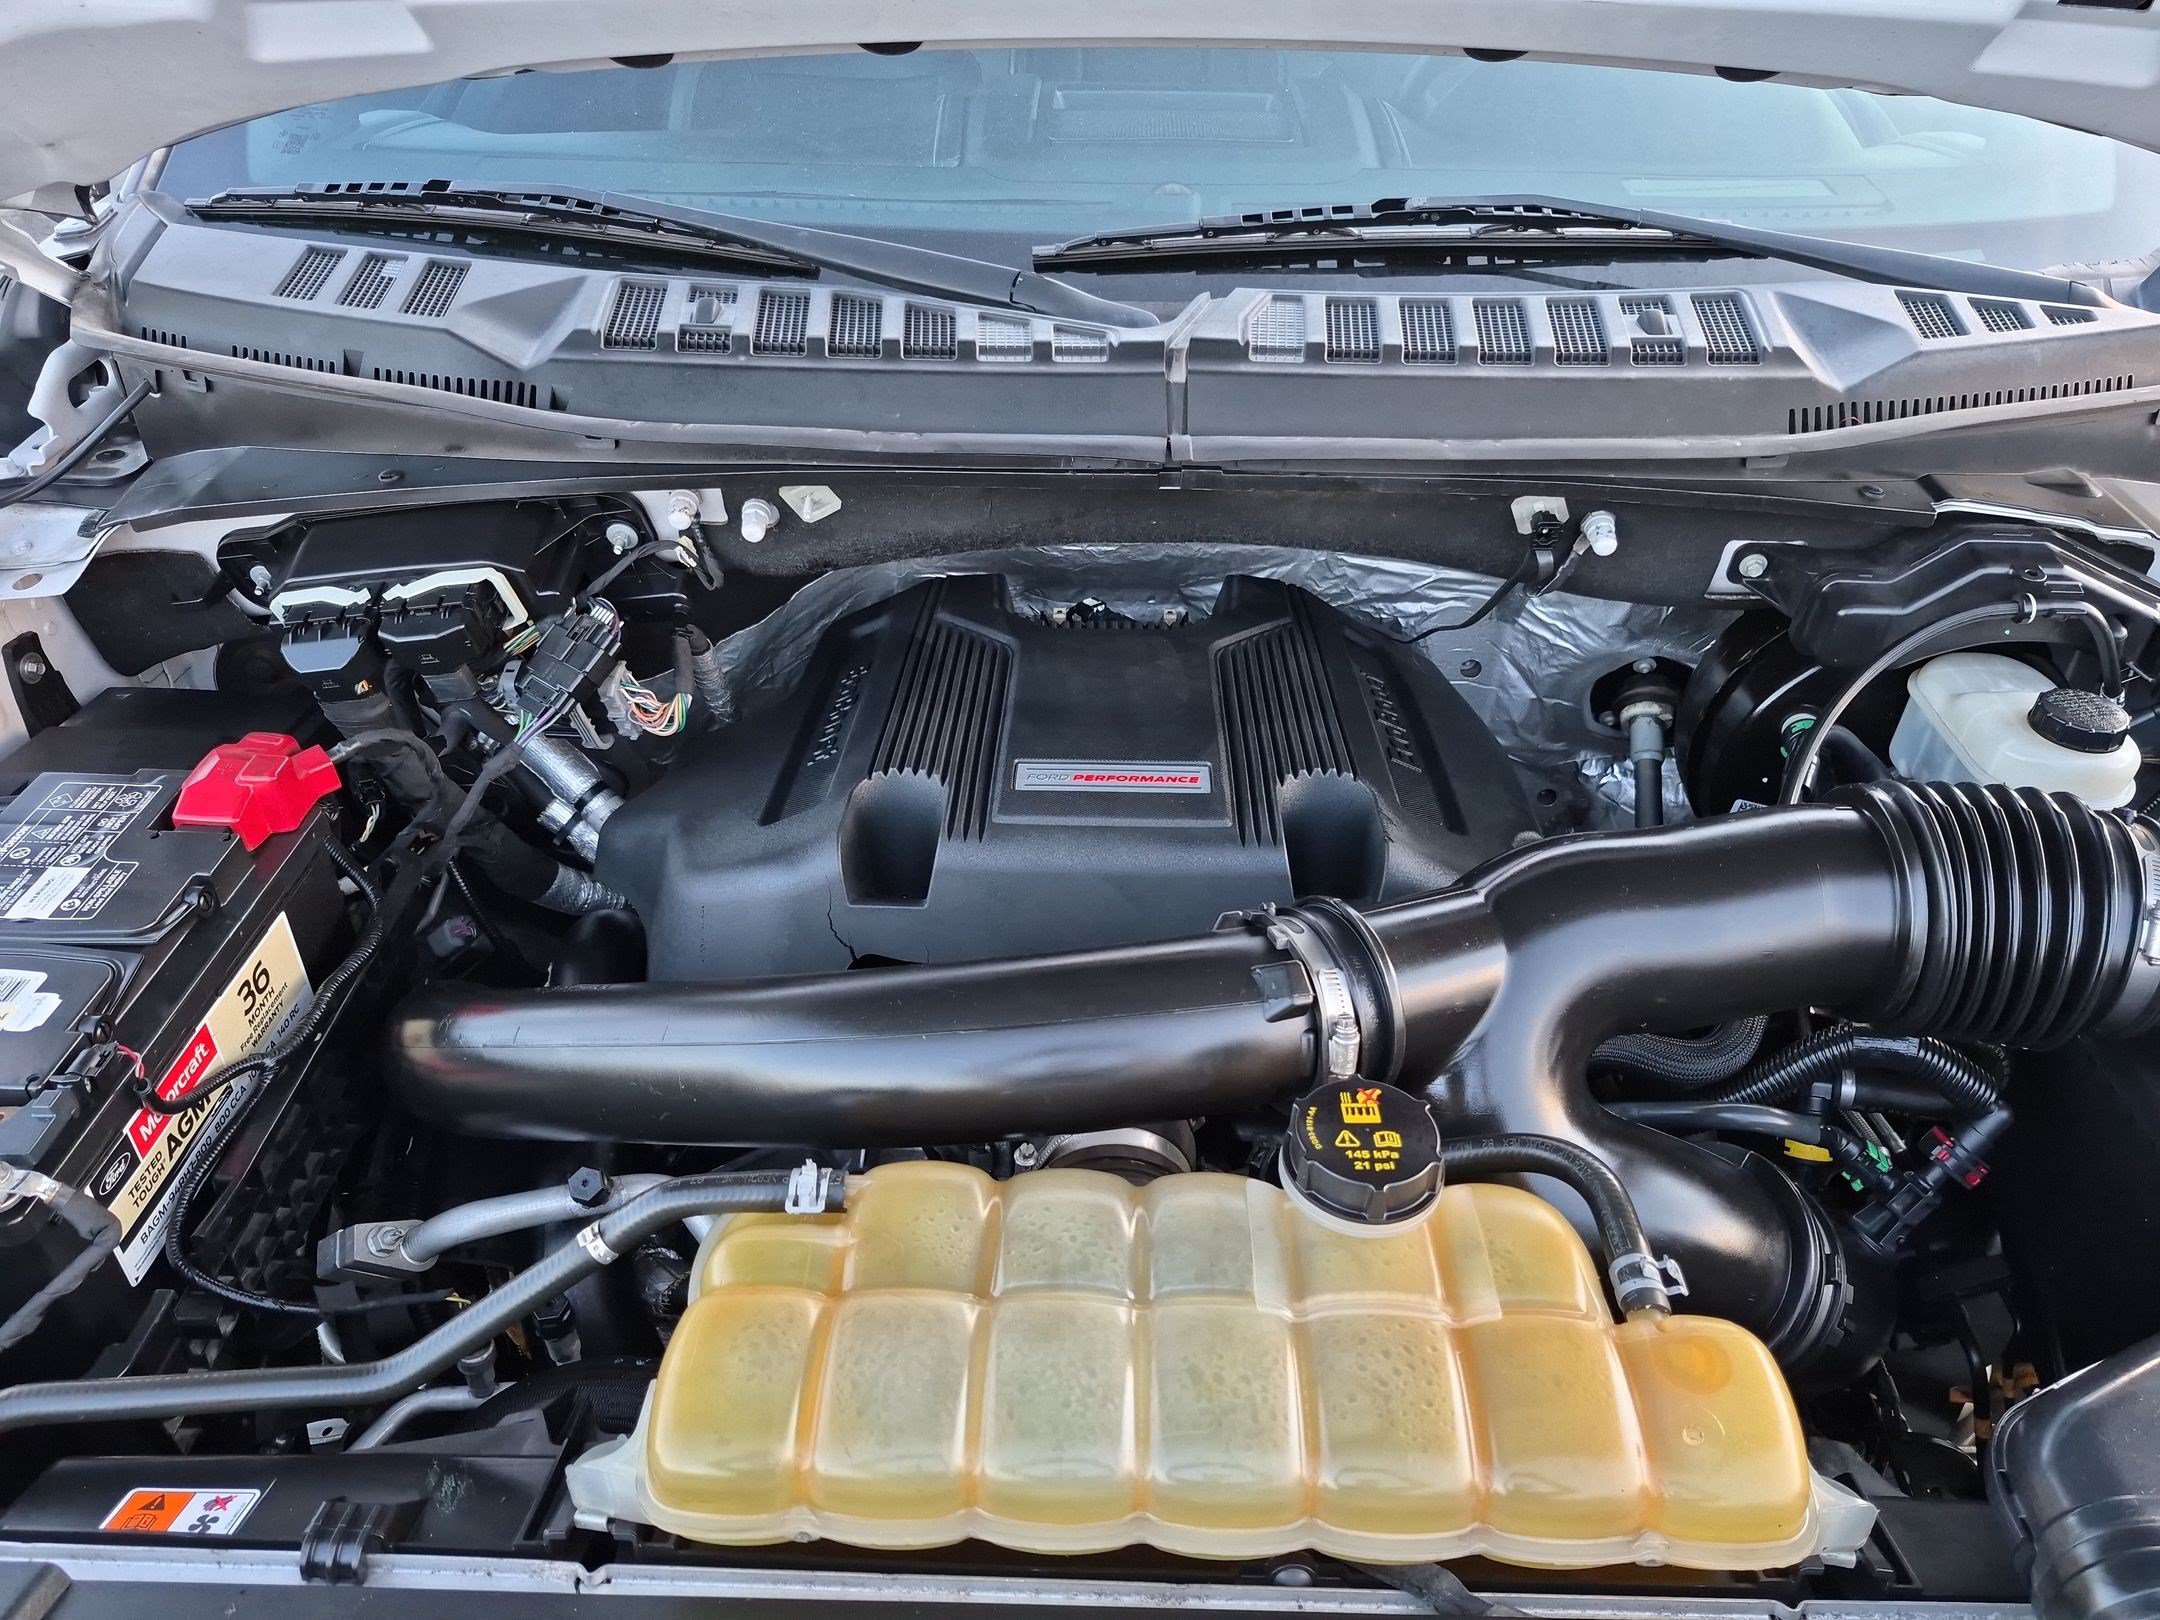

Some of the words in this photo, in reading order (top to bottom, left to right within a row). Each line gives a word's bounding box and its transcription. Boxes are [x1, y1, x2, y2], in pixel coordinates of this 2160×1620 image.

[1027, 772, 1070, 781] FORD
[1073, 774, 1200, 784] PERFORMANCE
[236, 959, 270, 1016] 36
[248, 986, 276, 1028] MONTH
[240, 1033, 254, 1053] Free
[253, 982, 288, 1034] Replacement
[251, 1000, 284, 1048] WARRANTY
[138, 1042, 210, 1142] Moorcraft
[214, 1108, 231, 1134] 800
[230, 1085, 247, 1109] CCA
[276, 1019, 290, 1038] 140
[289, 1004, 300, 1022] RC
[165, 1094, 212, 1161] AGM
[128, 1150, 163, 1199] TESTED
[1345, 1150, 1370, 1159] 145
[1373, 1150, 1399, 1159] kPa
[1353, 1161, 1370, 1170] 21
[1374, 1161, 1395, 1171] psi
